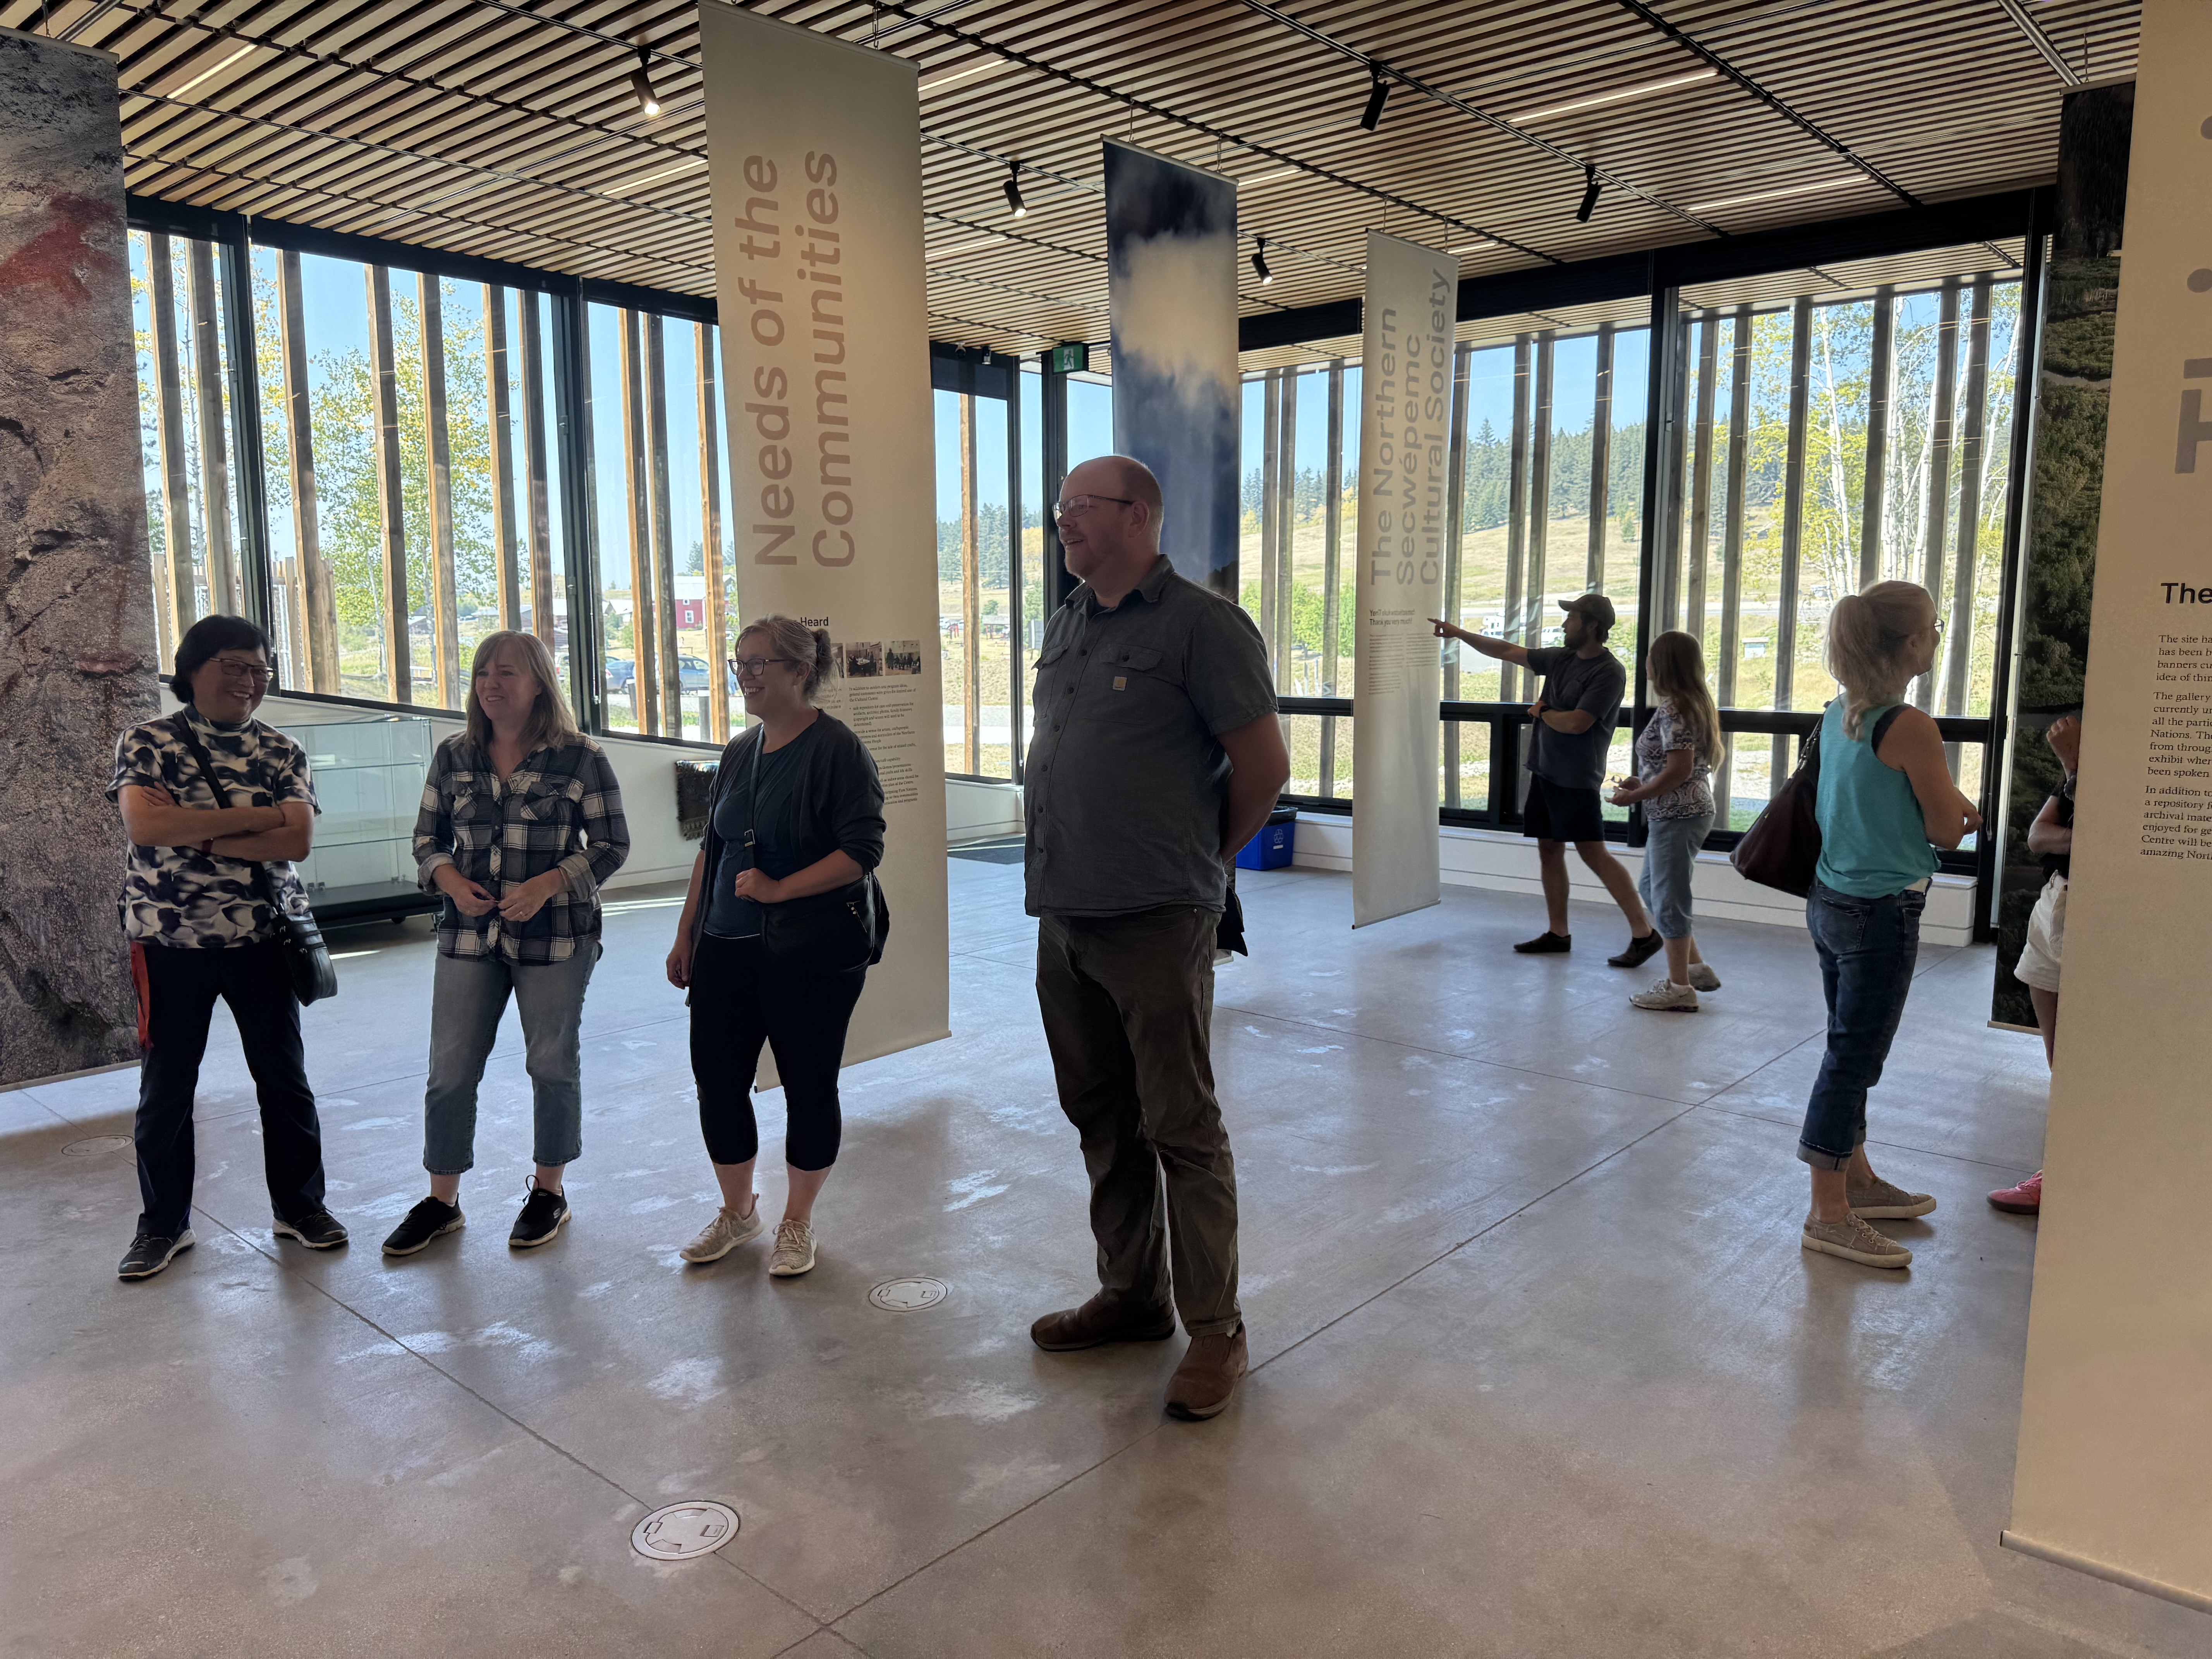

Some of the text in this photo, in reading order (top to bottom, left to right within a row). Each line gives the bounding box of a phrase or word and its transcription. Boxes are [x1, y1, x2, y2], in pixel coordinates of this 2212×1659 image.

[735, 155, 797, 565] Needs of the
[795, 151, 855, 567] Communities
[1420, 268, 1450, 585] Cultural Society
[1371, 308, 1396, 586] The Northern
[1396, 334, 1422, 586] Secwépemc
[2160, 583, 2212, 604] The
[800, 617, 829, 627] Heard
[2158, 635, 2178, 643] The
[2181, 635, 2198, 643] site
[2158, 647, 2175, 656] has
[2179, 648, 2202, 656] been
[2157, 660, 2197, 669] banners
[2156, 672, 2177, 681] idea
[2153, 692, 2211, 702] The gallery
[2154, 705, 2199, 715] currently
[2152, 717, 2164, 725] all
[2169, 718, 2183, 726] the
[2150, 729, 2192, 739] Nations.
[2149, 742, 2212, 754] from throug
[2148, 755, 2212, 765] exhibit wher
[2147, 766, 2209, 778] been spoken
[2145, 785, 2156, 793] In
[2159, 787, 2201, 796] addition
[2153, 800, 2204, 811] repository
[2143, 810, 2212, 822] archival mate
[2143, 823, 2181, 833] enjoyed
[2183, 825, 2198, 833] for
[2141, 835, 2212, 847] Centre will be
[2140, 849, 2212, 860] amazing Nort
